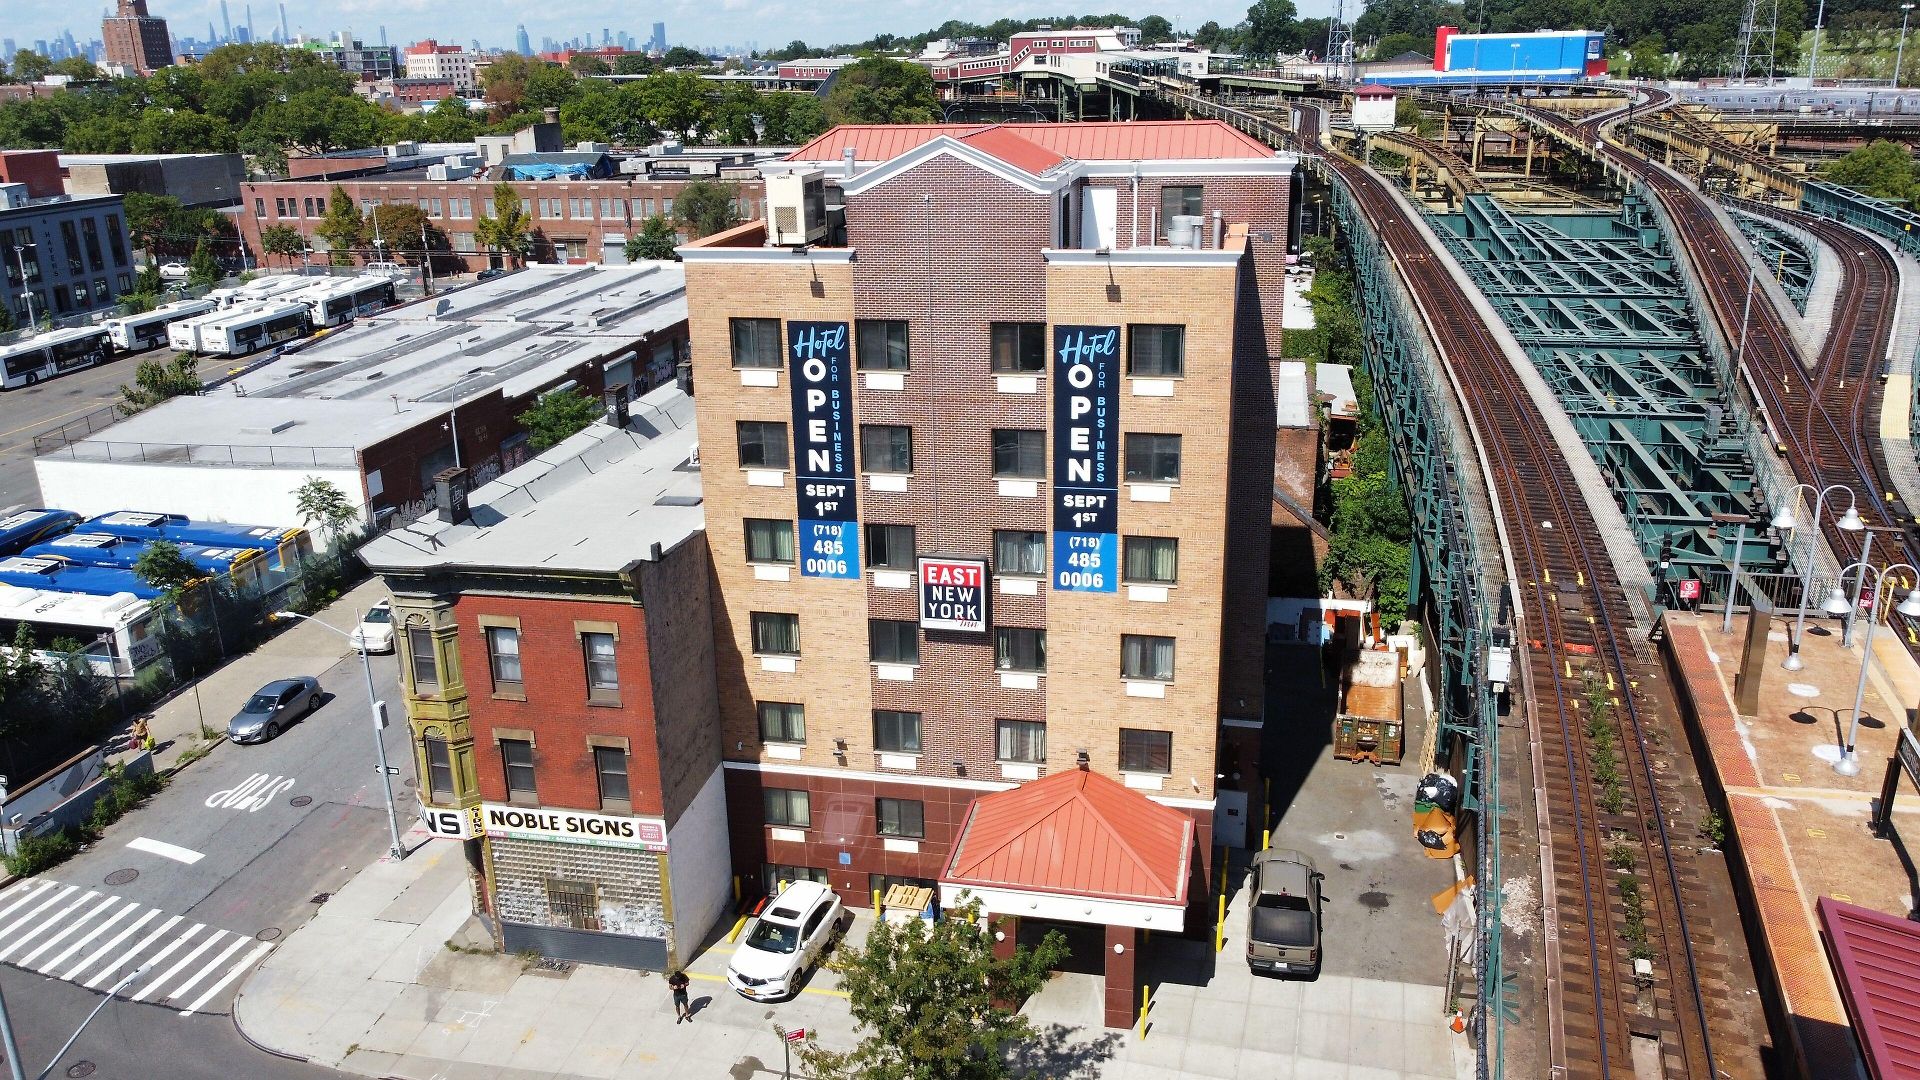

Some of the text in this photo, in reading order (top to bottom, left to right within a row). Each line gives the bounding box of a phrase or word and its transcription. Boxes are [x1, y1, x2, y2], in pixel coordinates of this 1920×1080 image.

[793, 325, 845, 359] Hotel
[1058, 329, 1116, 365] Hotel
[803, 358, 831, 472] OPEN
[830, 356, 844, 473] FOR BUSINESS
[1068, 363, 1093, 482] OPEN
[1096, 362, 1106, 483] FOR BUSINESS
[805, 484, 846, 498] SEPT
[815, 501, 839, 517] 1ST
[1063, 494, 1107, 508] SEPT
[1072, 512, 1098, 528] 1ST
[813, 524, 842, 537] (718)
[813, 540, 844, 555] 485
[1069, 536, 1100, 550] (718)
[806, 558, 847, 574] 0006
[1068, 552, 1101, 568] 485
[927, 566, 978, 586] EAST
[1060, 571, 1104, 588] 0006
[932, 586, 974, 603] NEW
[928, 603, 978, 620] YORK
[205, 773, 296, 812] STOP
[489, 810, 560, 831] NOBLE
[566, 817, 634, 838] SIGNS
